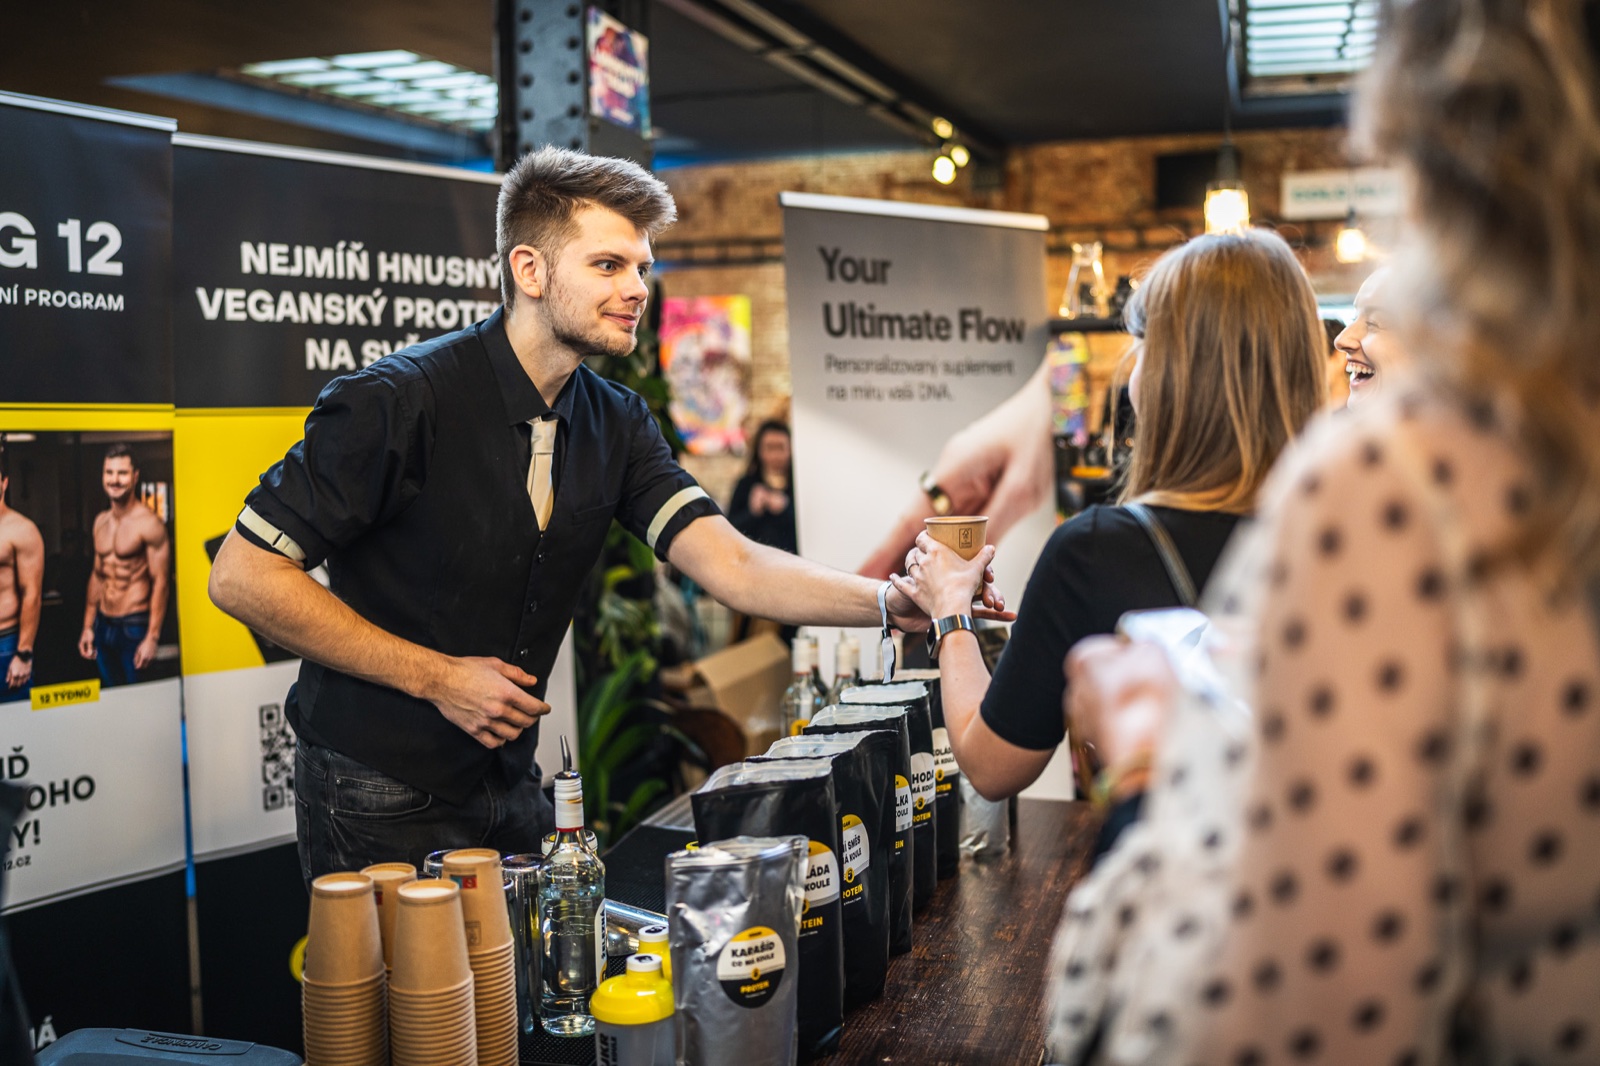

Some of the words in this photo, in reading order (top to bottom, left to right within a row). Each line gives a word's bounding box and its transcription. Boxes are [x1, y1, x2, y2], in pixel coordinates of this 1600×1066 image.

[57, 218, 123, 276] 12
[240, 240, 370, 282] NEJMÍŇ
[816, 246, 891, 285] Your
[24, 288, 124, 312] PROGRAM
[195, 287, 388, 327] VEGANSKÝ
[393, 296, 498, 329] PROTE
[823, 301, 952, 341] Ultimate
[958, 307, 1025, 343] Flow
[305, 338, 356, 371] NA
[800, 916, 823, 929] TEIN
